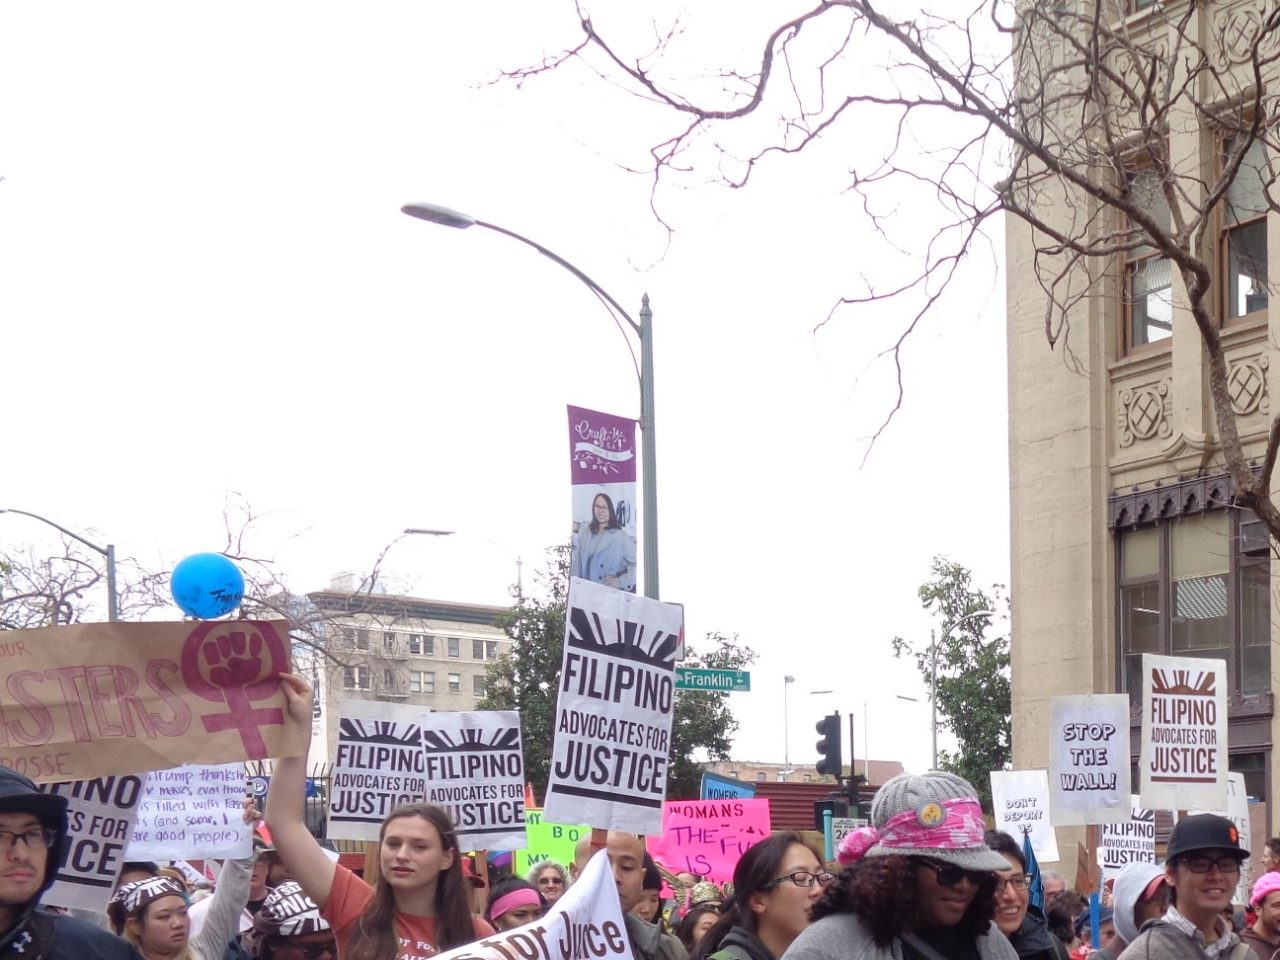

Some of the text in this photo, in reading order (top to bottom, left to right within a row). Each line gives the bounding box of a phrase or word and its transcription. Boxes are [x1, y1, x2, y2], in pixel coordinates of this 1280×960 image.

[563, 653, 672, 714] FILIPINO
[684, 671, 733, 688] Franklin
[1151, 697, 1217, 726] FILIPINO
[559, 708, 668, 753] ADVOCATES FOR
[1063, 722, 1116, 742] STOP
[1151, 729, 1217, 745] ADVOCATES FOR
[336, 744, 424, 774] FILIPINO
[427, 753, 522, 780] FILIPINO
[1070, 747, 1108, 766] THE
[1150, 748, 1217, 774] JUSTICE
[554, 739, 667, 795] JUSTICE
[334, 773, 425, 793] ADVOCATES FOR
[1060, 773, 1117, 791] WALL!
[430, 783, 524, 803] ADVOCATES FOR
[1005, 797, 1037, 809] DON'T
[445, 800, 526, 826] USTICE
[1003, 810, 1043, 822] DEPORT
[88, 815, 129, 840] FOR
[155, 830, 185, 841] good
[670, 826, 719, 846] THE
[1017, 823, 1033, 834] US
[1103, 823, 1154, 838] FILIPINO
[1103, 838, 1140, 851] ADVOCATES
[686, 855, 712, 875] IS
